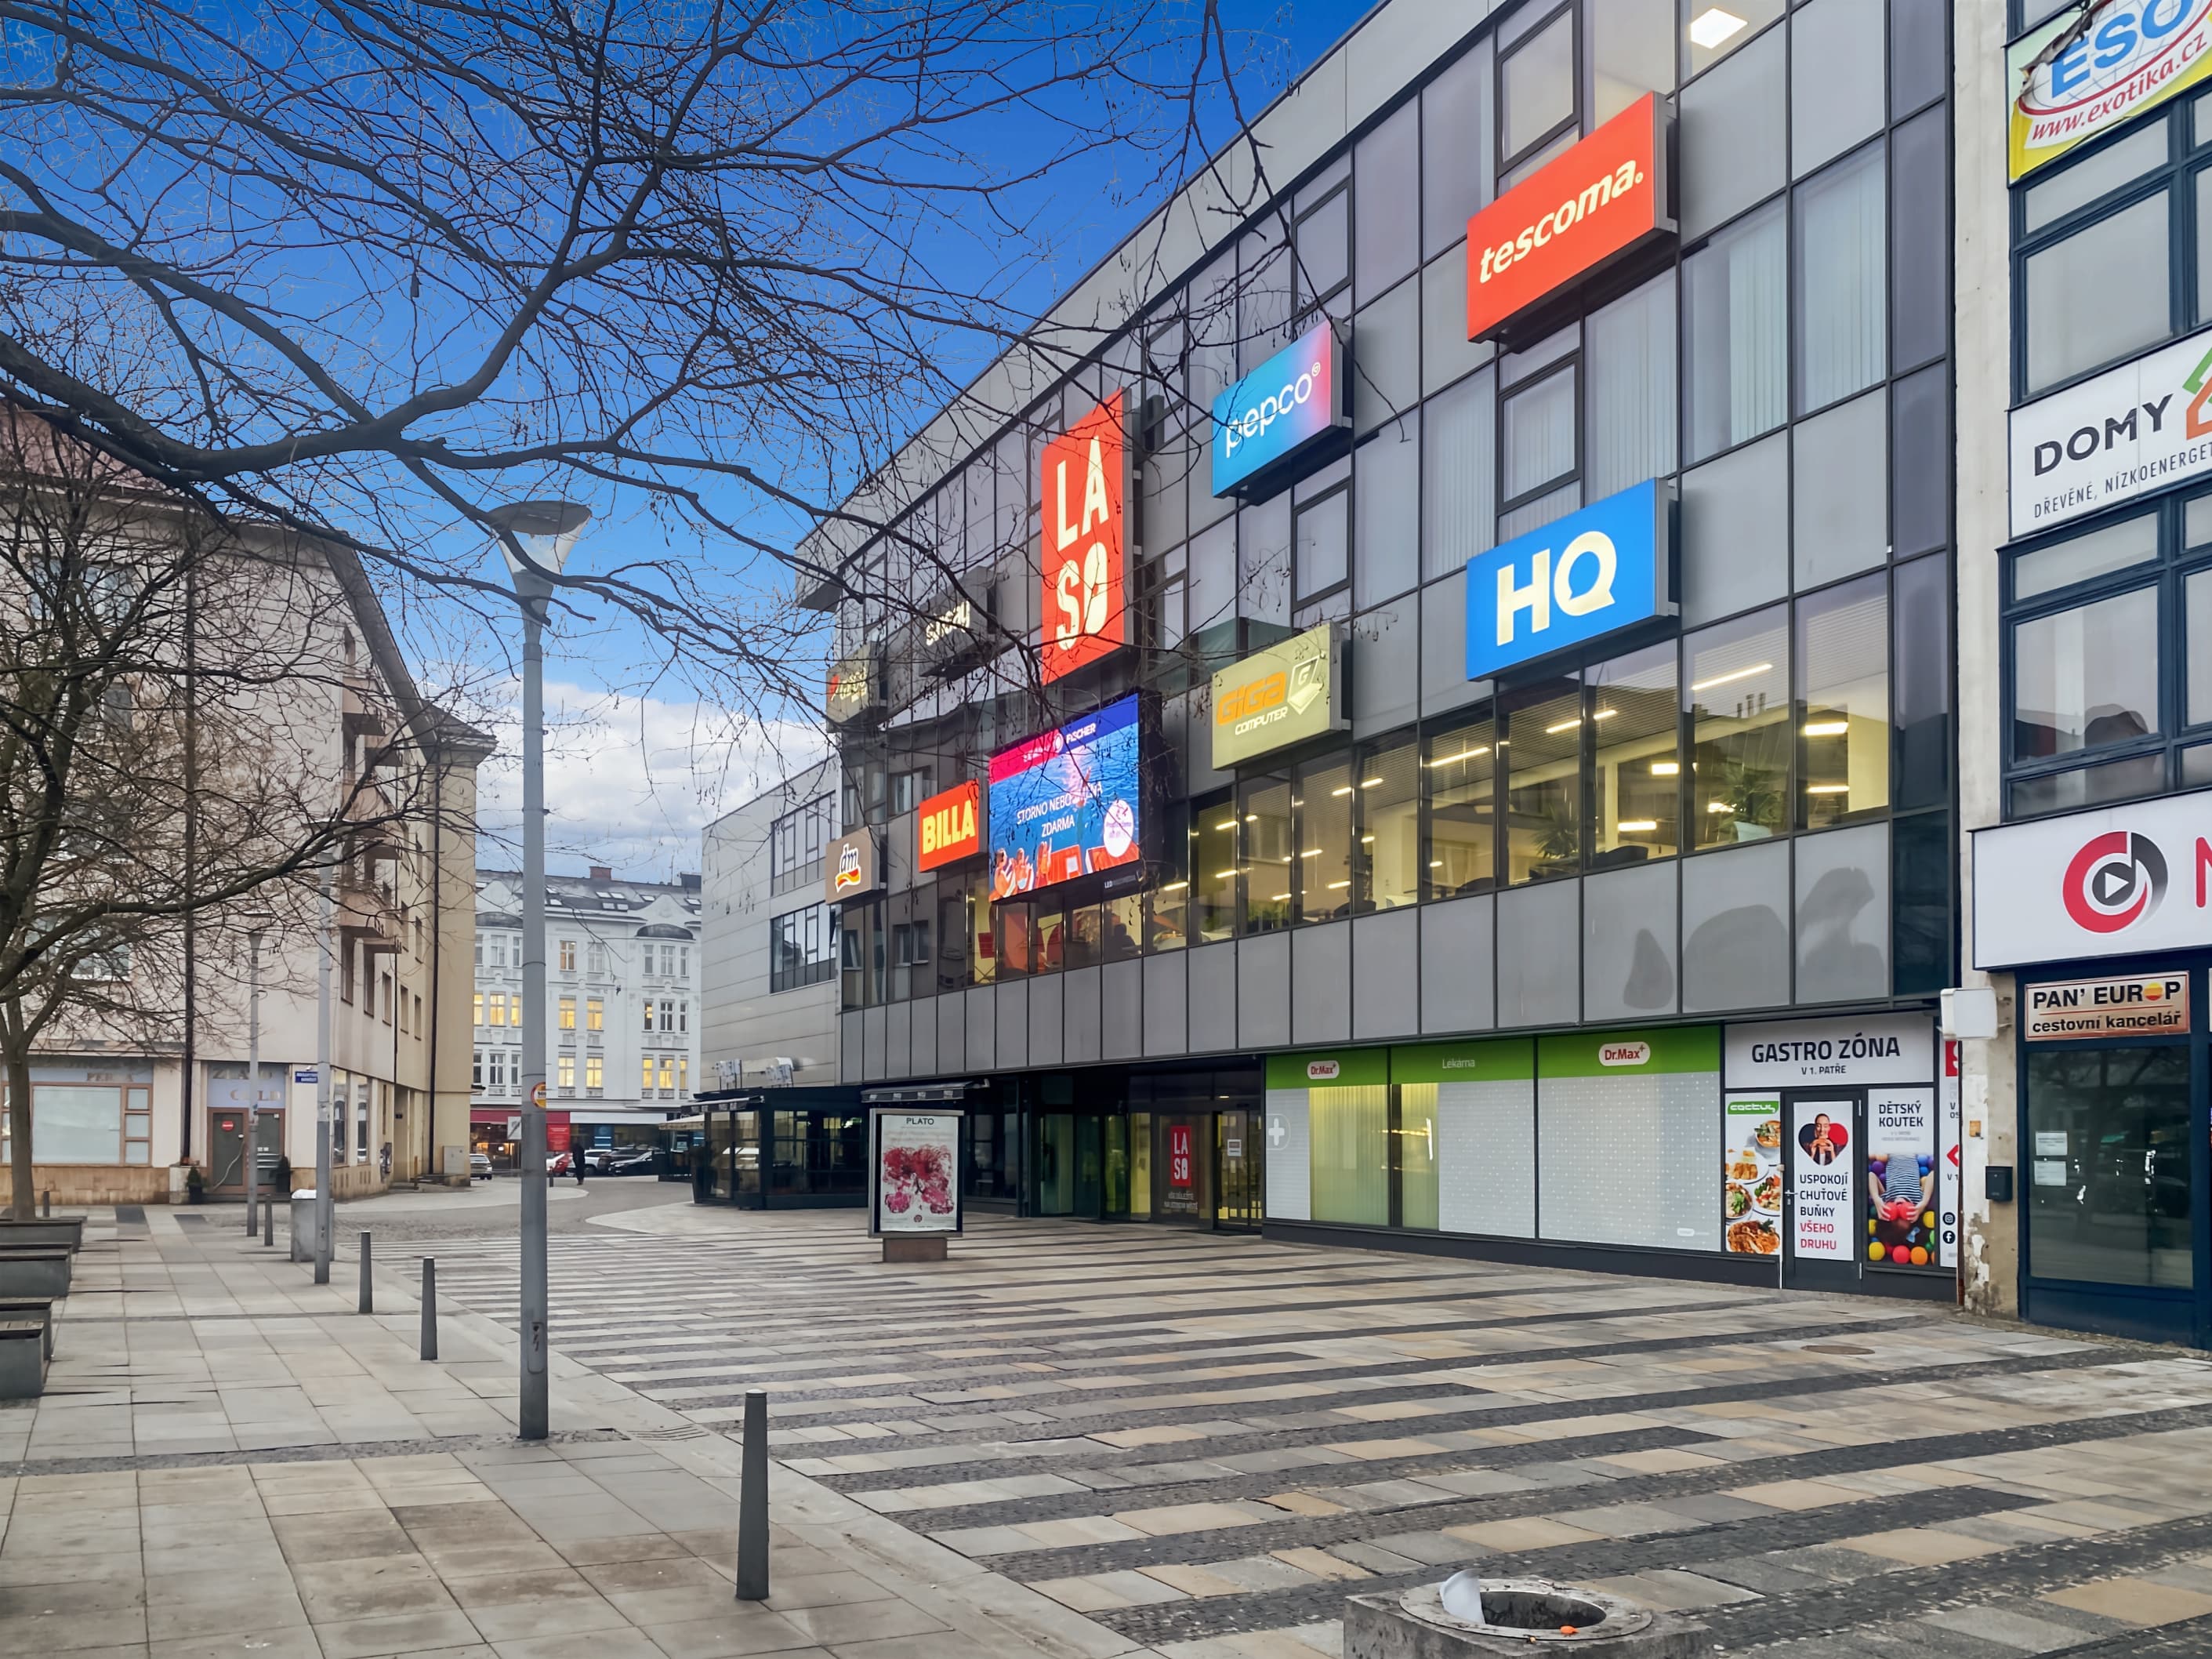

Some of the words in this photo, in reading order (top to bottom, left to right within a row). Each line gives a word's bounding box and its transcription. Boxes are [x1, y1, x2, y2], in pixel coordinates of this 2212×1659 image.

[2032, 31, 2207, 141] www.exotika.cz
[1480, 160, 1644, 283] tescoma.
[2035, 394, 2174, 477] DOMY
[2035, 481, 2098, 518] DŘEVĚNÉ,
[1497, 531, 1617, 647] HQ
[1235, 706, 1289, 735] COMPUTER
[1017, 801, 1048, 825] STORNO
[1049, 793, 1072, 811] NEBO
[923, 800, 976, 855] BILLA
[1042, 815, 1075, 838] ZDARMA
[2032, 1015, 2100, 1033] cestovní
[2105, 1010, 2182, 1029] kancelář
[1605, 1048, 1641, 1061] Dr.Max
[1752, 1040, 1833, 1062] GASTRO
[1838, 1032, 1901, 1059] ZÓNA
[1819, 1063, 1847, 1074] PATŘE
[1879, 1100, 1922, 1114] DĚTSKÝ
[1879, 1116, 1924, 1127] KOUTEK
[1800, 1171, 1848, 1185] USPOKOJÍ
[1800, 1188, 1848, 1201] CHUŤOVÉ
[1800, 1204, 1835, 1217] BUŇKY
[1800, 1220, 1834, 1233] VŠEHO
[1800, 1239, 1837, 1251] DRUHU
